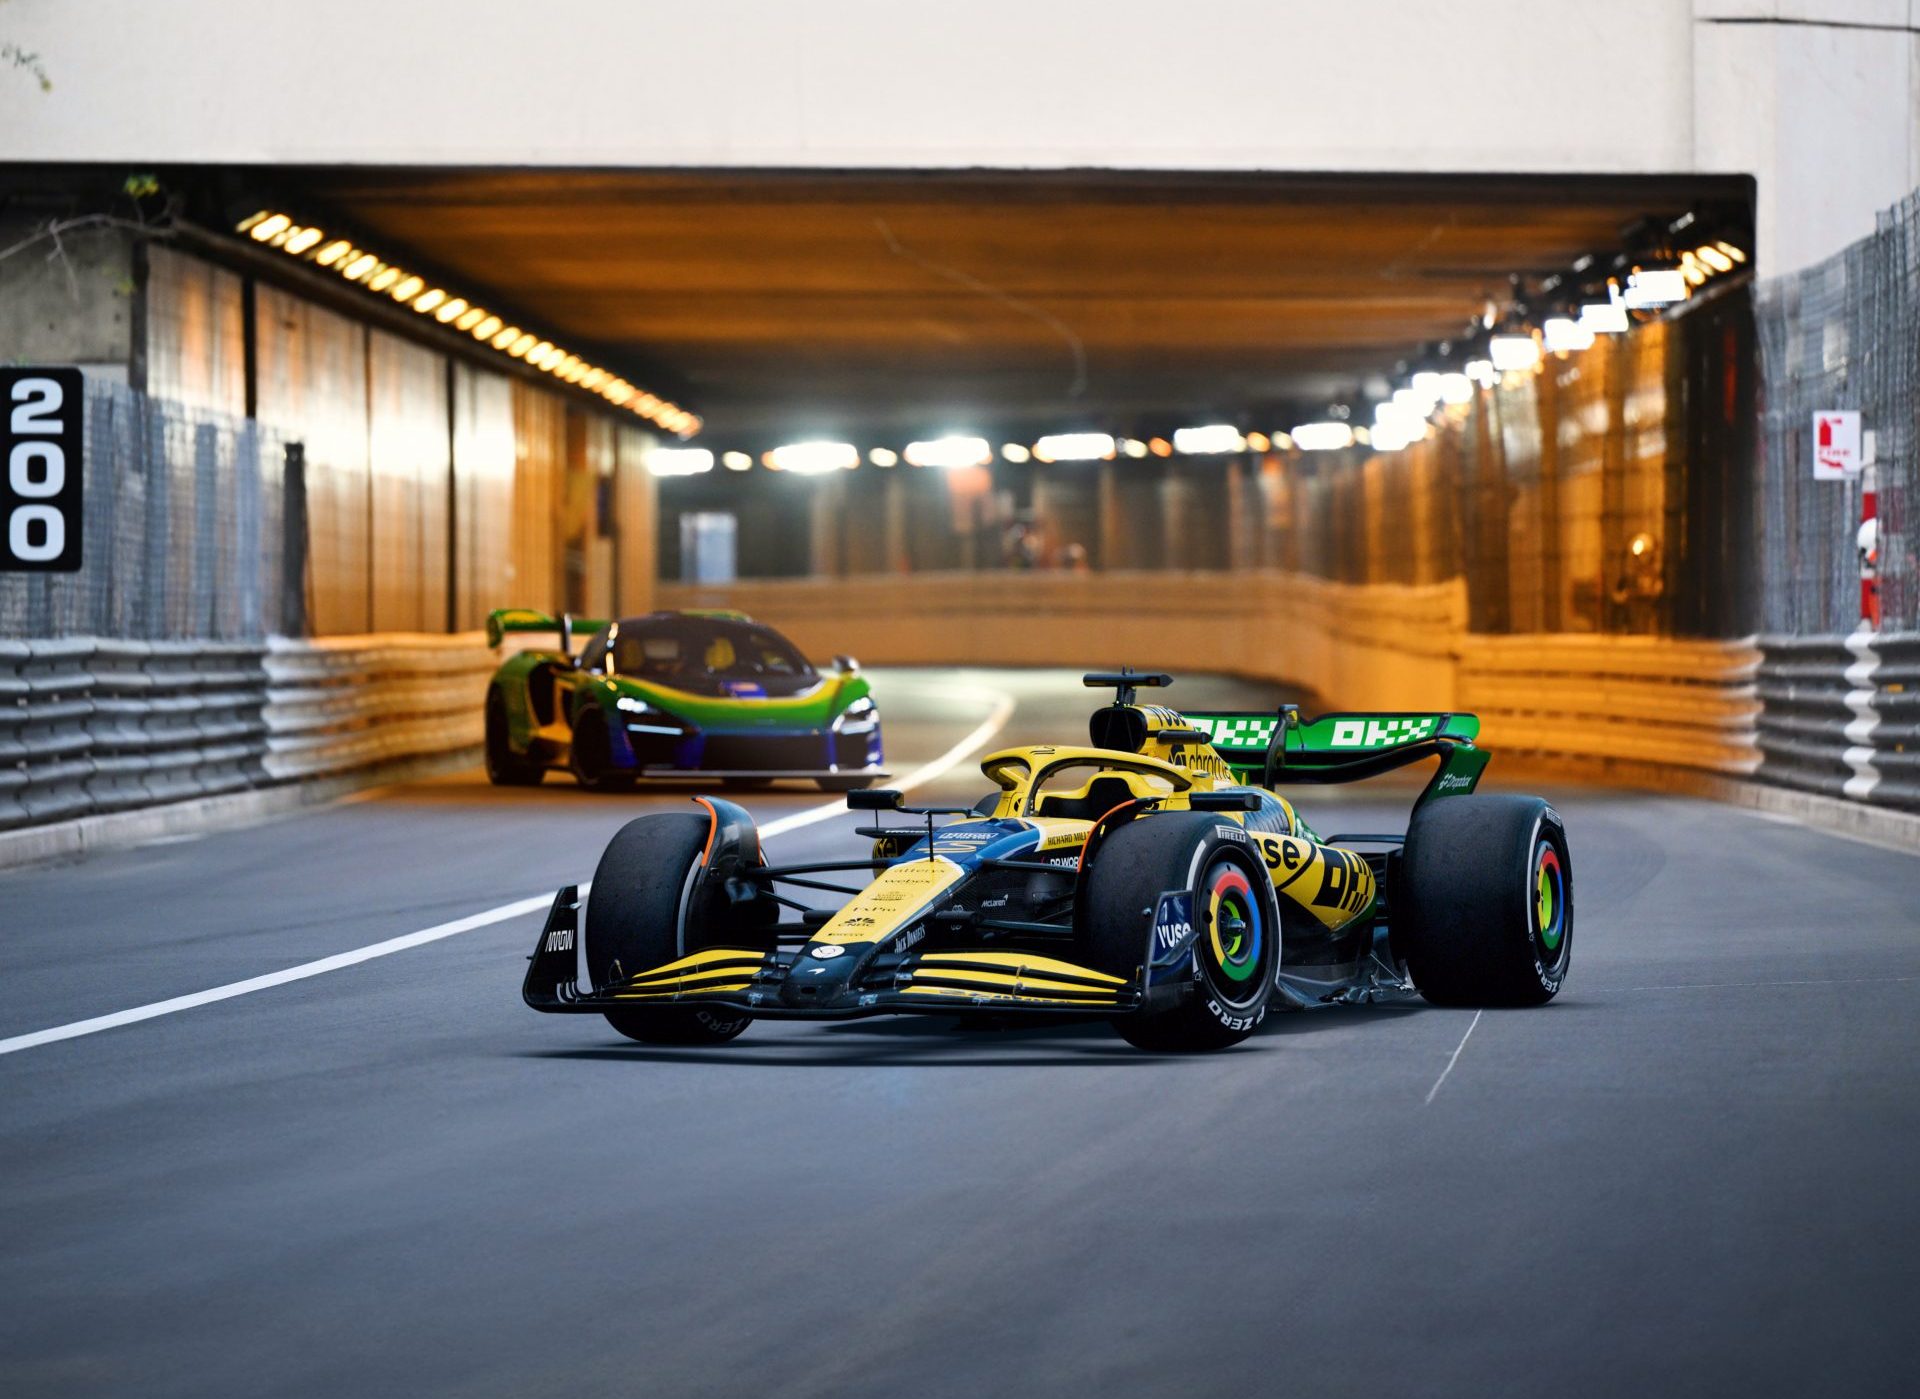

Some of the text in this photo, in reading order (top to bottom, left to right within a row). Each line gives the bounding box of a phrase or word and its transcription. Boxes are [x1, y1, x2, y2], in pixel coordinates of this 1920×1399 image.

[9, 377, 65, 561] 200
[1331, 718, 1432, 746] OKX
[1190, 744, 1231, 780] chrome
[1047, 834, 1073, 846] RICHARD
[1215, 824, 1246, 843] PIRELLI
[981, 899, 1006, 909] McLaren
[1207, 999, 1254, 1032] ZERO
